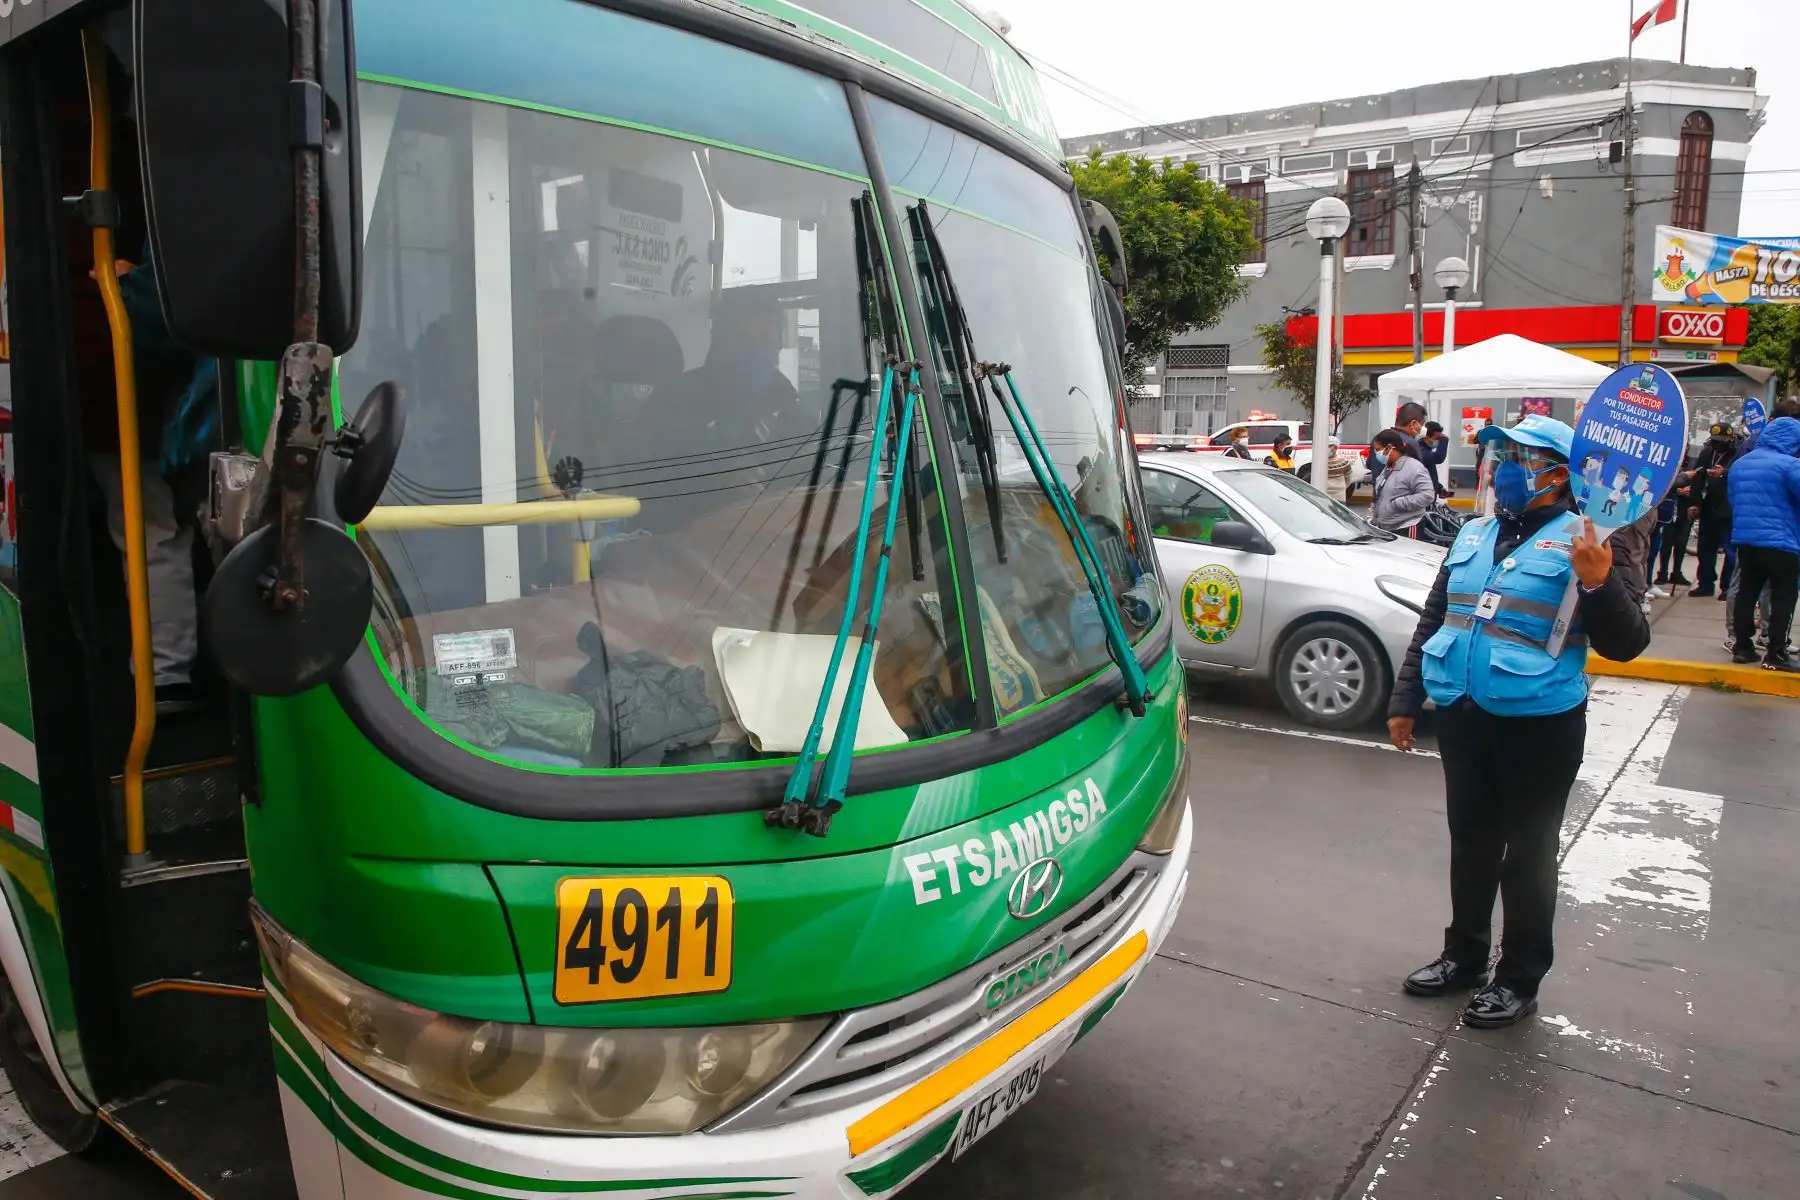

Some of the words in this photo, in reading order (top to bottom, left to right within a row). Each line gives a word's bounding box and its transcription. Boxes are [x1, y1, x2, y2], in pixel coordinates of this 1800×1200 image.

[1662, 279, 1688, 290] CALLAO
[1715, 267, 1749, 283] HASTA
[1751, 284, 1767, 297] DE
[1668, 313, 1724, 337] OXXO
[1603, 397, 1617, 407] POR
[1617, 401, 1625, 411] TU
[1626, 404, 1648, 417] SALUD
[1652, 413, 1662, 423] LA
[1662, 417, 1673, 426] DE
[1619, 390, 1662, 410] CONDUCTOR
[1609, 410, 1622, 421] TUS
[1621, 415, 1660, 433] PASAJEROS
[1582, 419, 1648, 459] ¡VACÚNATE
[1647, 441, 1671, 467] YA!
[448, 661, 481, 672] AFF-896
[903, 777, 1107, 906] ETSAMIGSA
[564, 886, 719, 985] 4911
[986, 942, 1069, 1009] CINCA
[959, 1059, 1041, 1150] AFF-896
